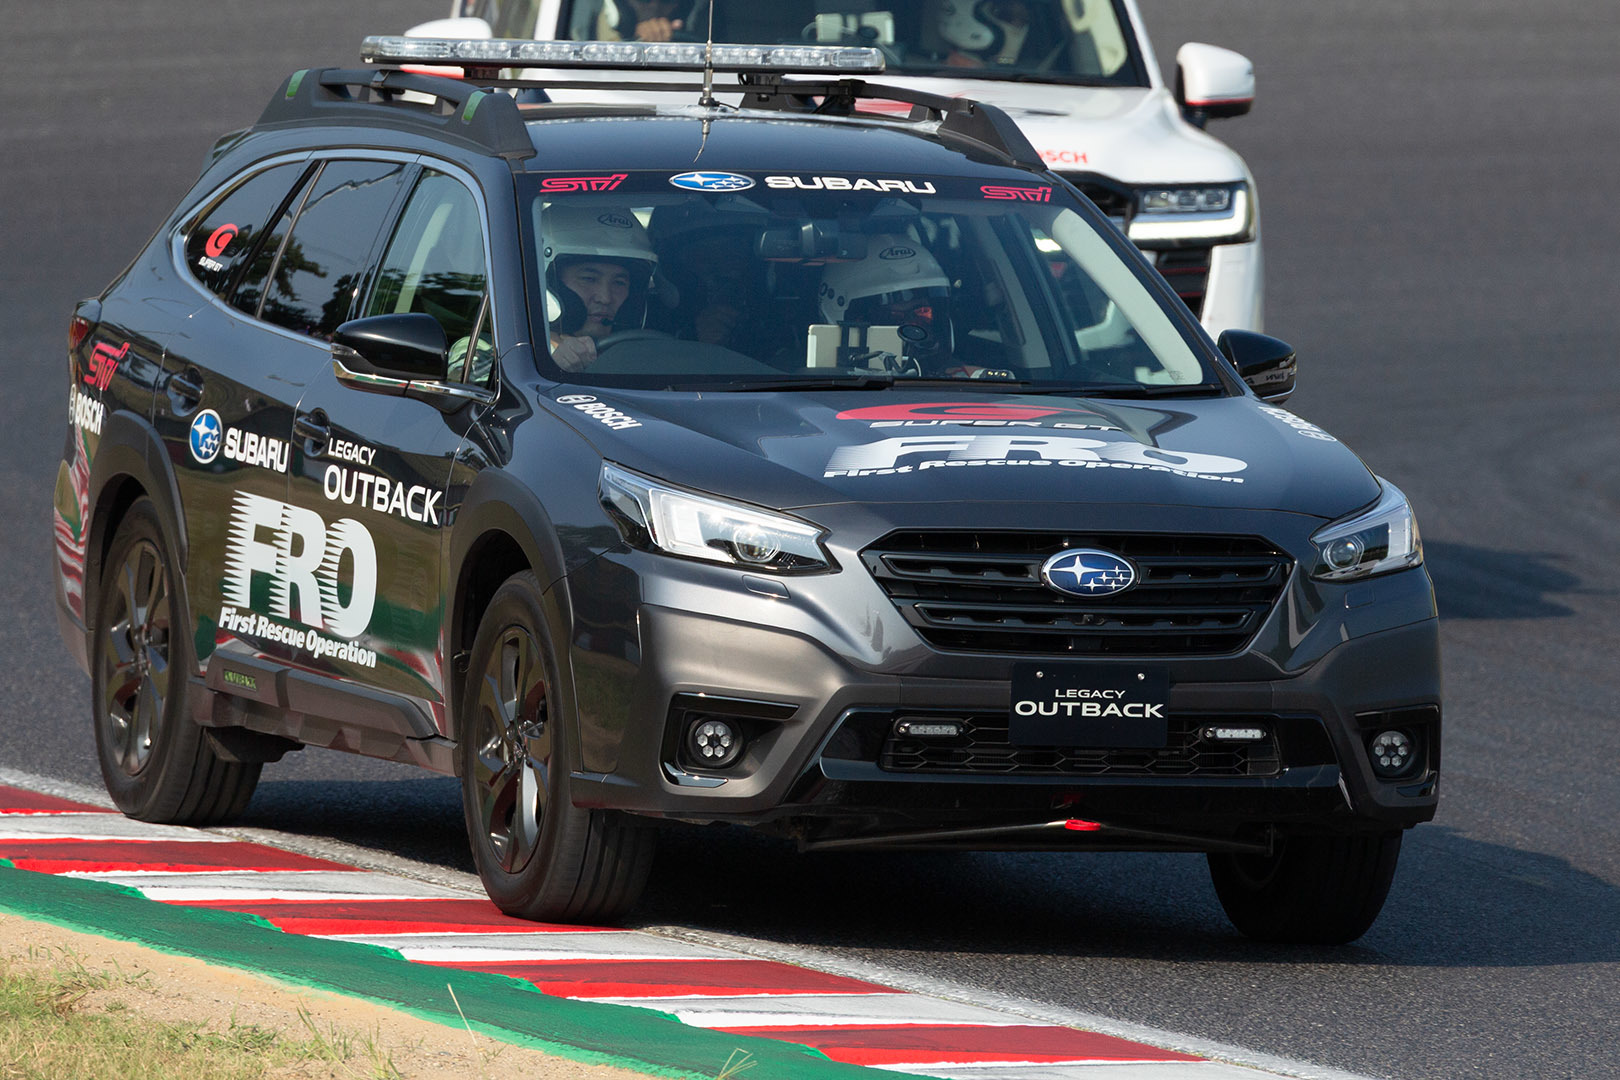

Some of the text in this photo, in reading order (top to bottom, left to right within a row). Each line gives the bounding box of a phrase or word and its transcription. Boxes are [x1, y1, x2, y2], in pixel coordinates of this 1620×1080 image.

[1036, 149, 1088, 163] SCH
[764, 176, 937, 195] SUBARU
[75, 392, 105, 436] BOSCH
[573, 402, 643, 431] BOSCH
[869, 420, 1123, 431] SUPER GT
[223, 426, 290, 473] SUBARU
[327, 437, 377, 466] LEGACY
[824, 435, 1248, 474] FRO
[823, 460, 1245, 484] First Rescue Operation
[324, 464, 443, 526] OUTBACK
[222, 489, 378, 638] FRO
[218, 606, 377, 669] First Rescue Operation
[1055, 689, 1126, 699] LEGACY
[1014, 700, 1165, 719] OUTBACK
